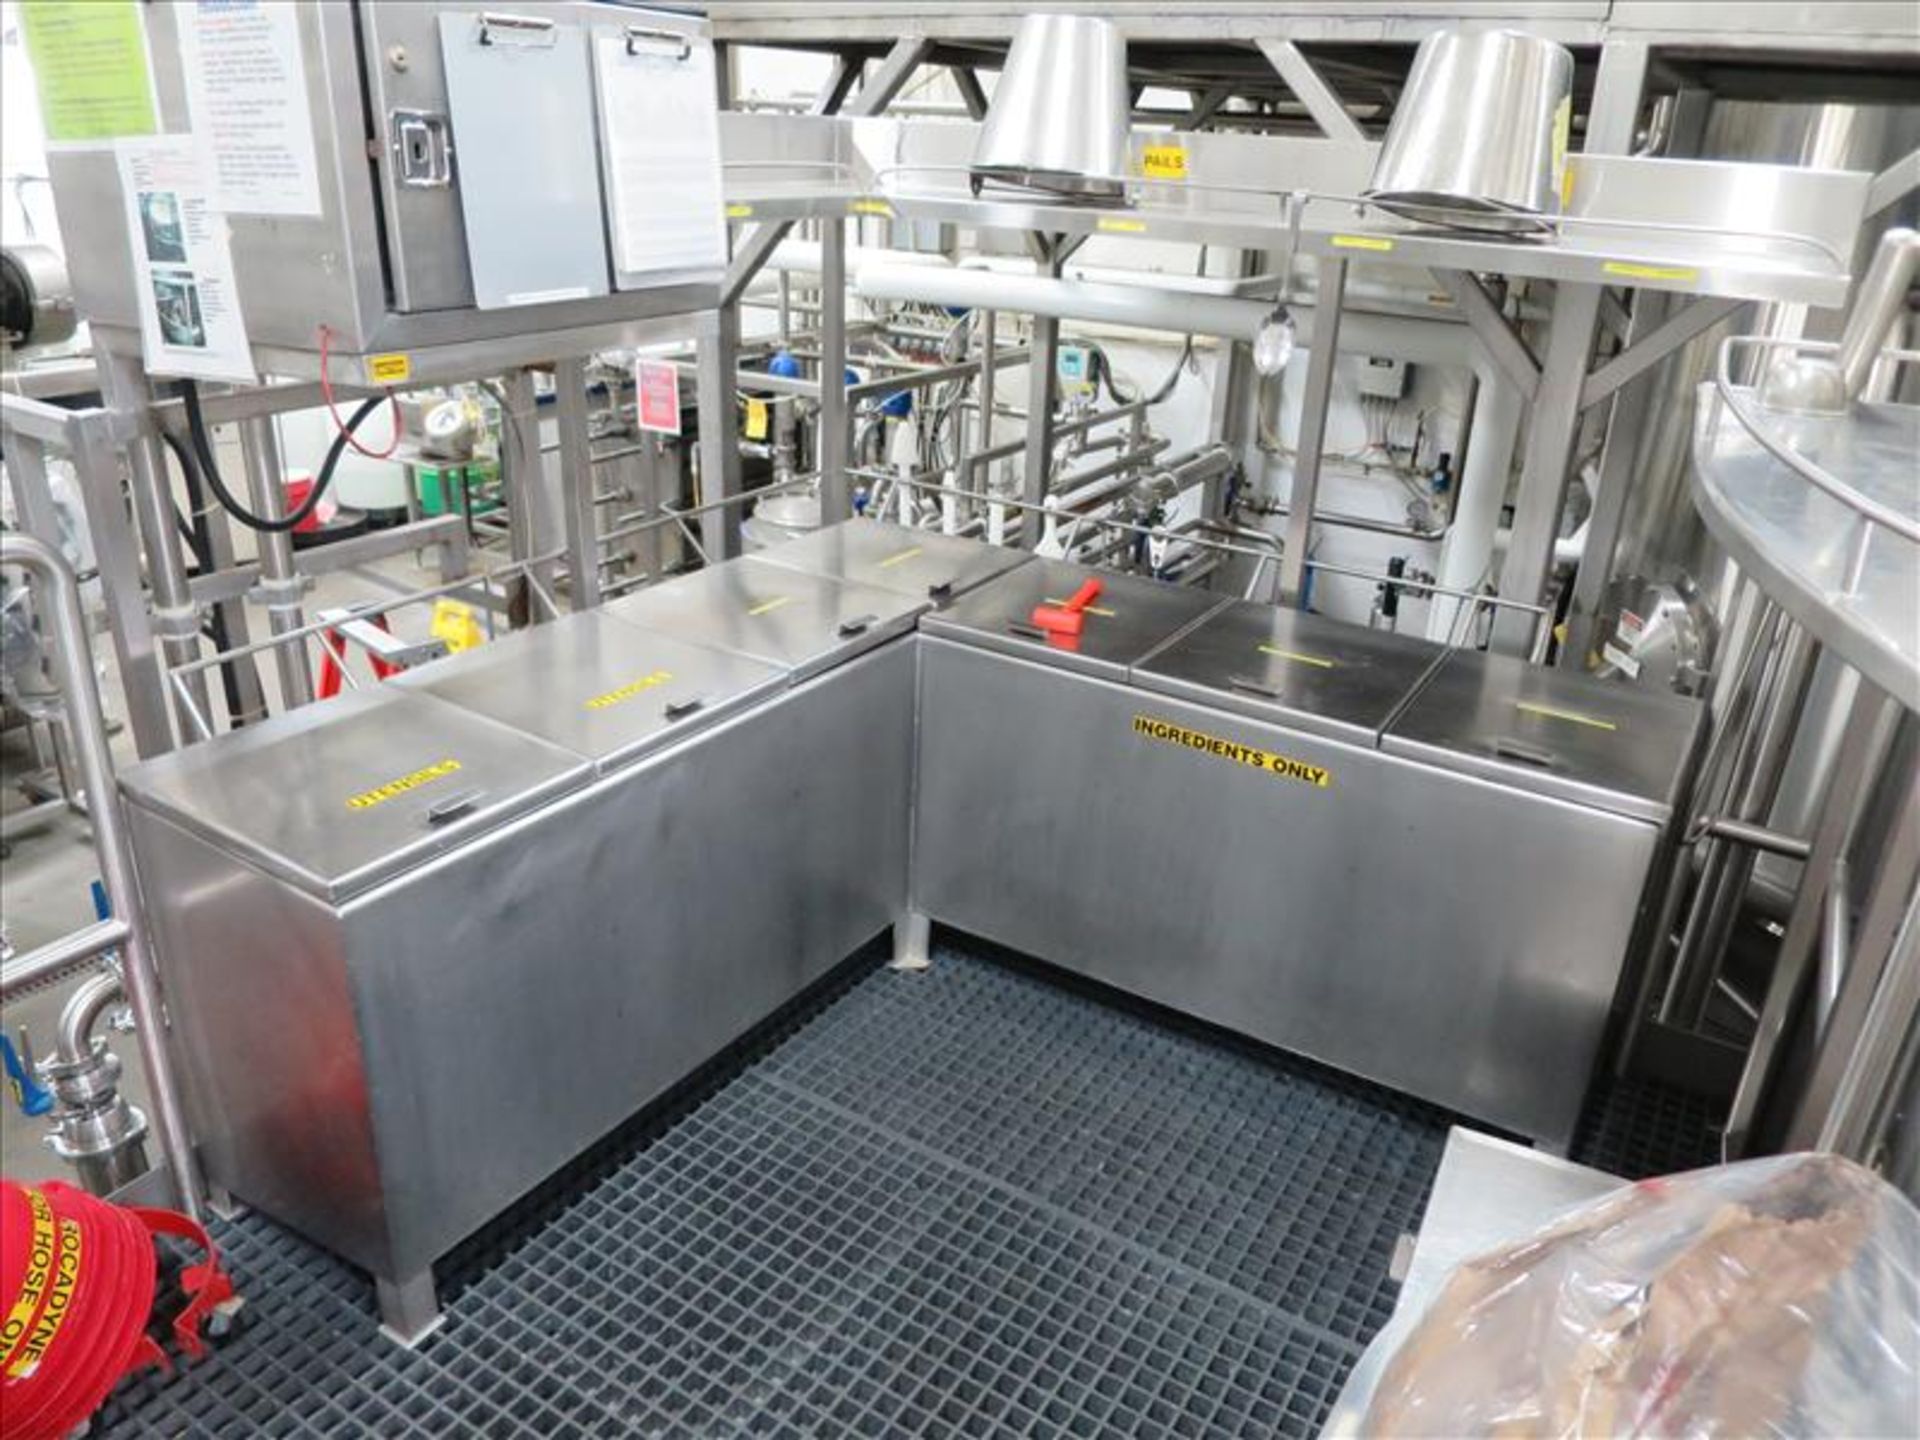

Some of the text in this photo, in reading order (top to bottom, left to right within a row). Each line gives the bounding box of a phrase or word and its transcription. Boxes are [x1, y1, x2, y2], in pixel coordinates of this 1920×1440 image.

[1144, 155, 1184, 169] PAILS
[1134, 718, 1325, 785] INGREDIENTS ONLY
[19, 1231, 52, 1307] HOSE
